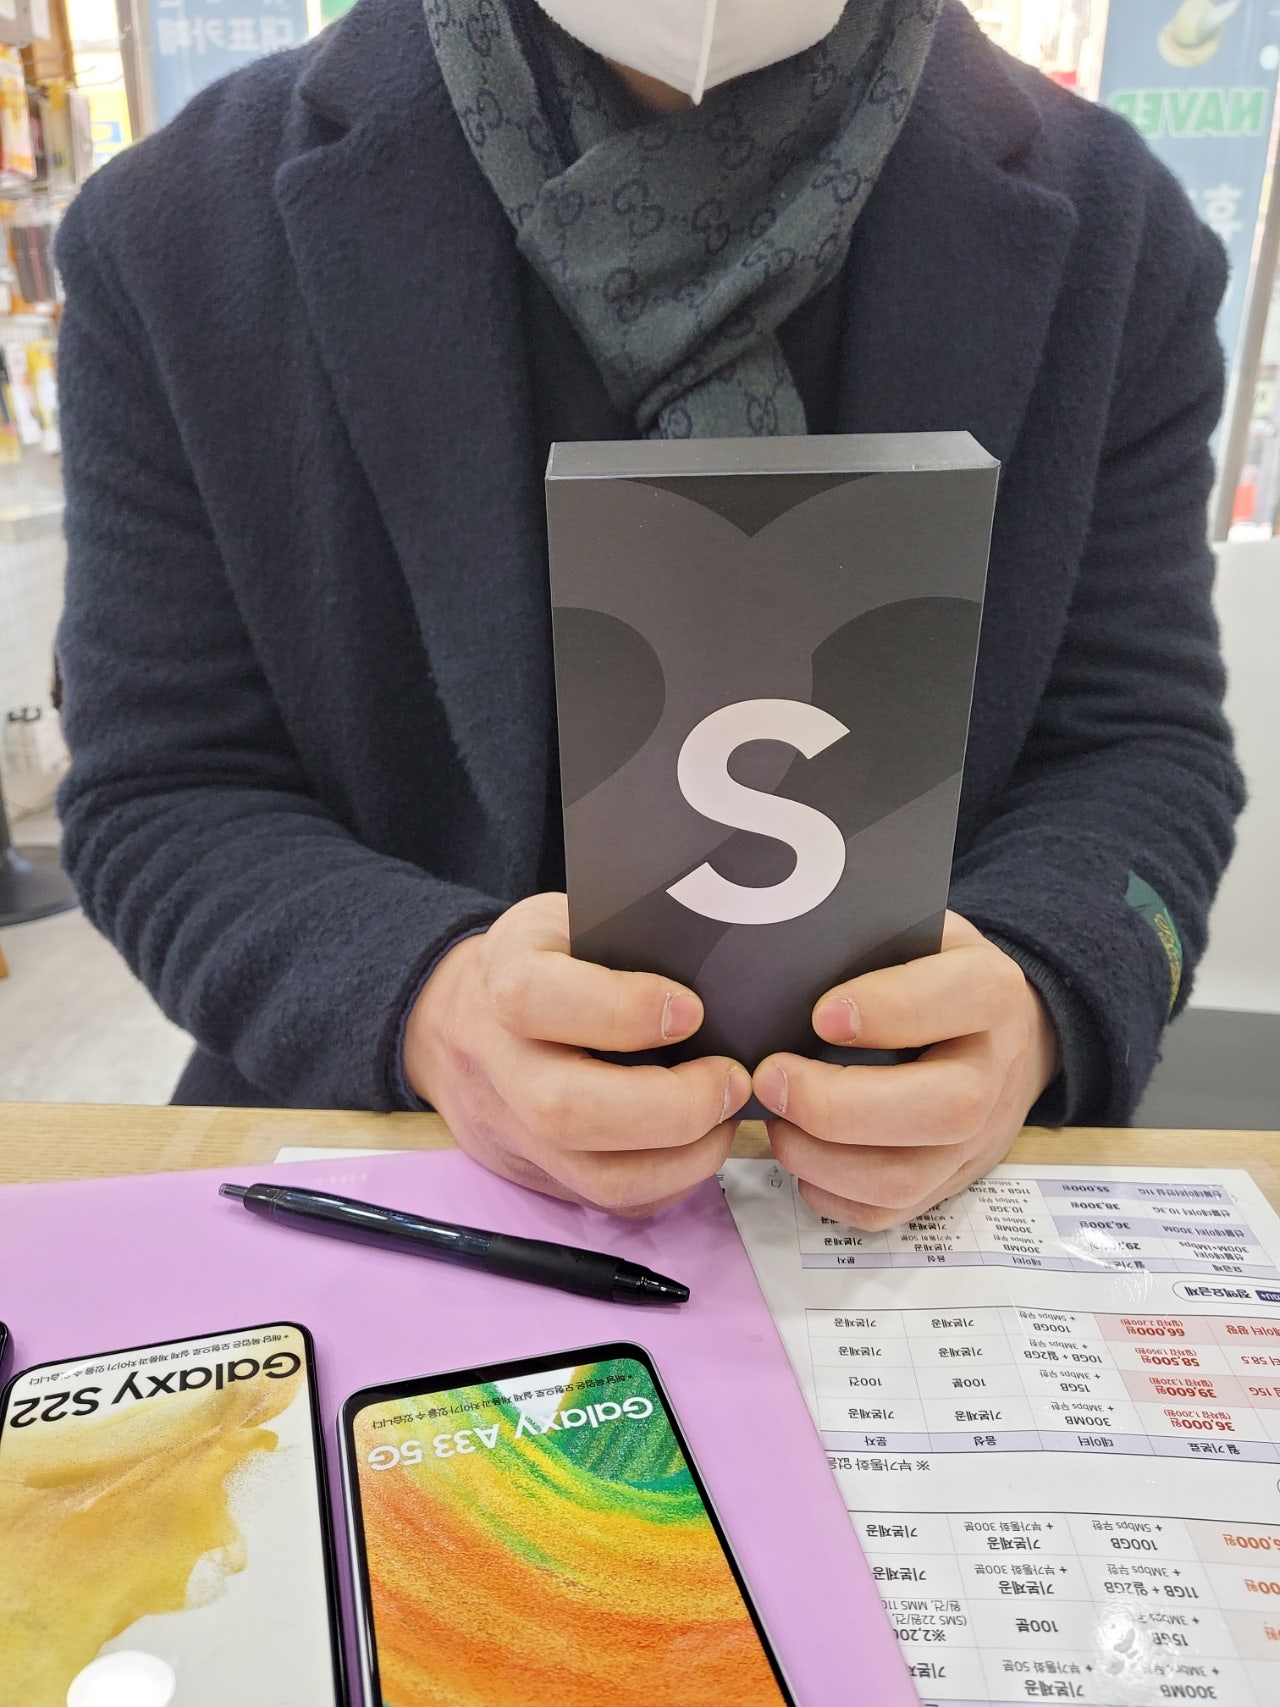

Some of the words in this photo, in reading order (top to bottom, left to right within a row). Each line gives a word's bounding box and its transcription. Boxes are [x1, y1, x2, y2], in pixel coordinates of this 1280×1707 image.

[665, 698, 850, 925] S
[1062, 1185, 1110, 1193] 55,000원
[995, 1224, 1032, 1234] 300MB
[1079, 1221, 1131, 1229] 36,300원
[1162, 1225, 1194, 1235] 300M
[824, 1237, 862, 1246] 기본제공
[1010, 1236, 1035, 1244] 1Mbps
[914, 1244, 953, 1252] 기본제공
[1003, 1244, 1040, 1254] 300MB
[837, 1256, 855, 1264] 문자
[1012, 1256, 1042, 1266] 데이터
[1212, 1264, 1242, 1273] 요금제
[1184, 1286, 1251, 1299] 정액요금제
[1019, 1311, 1036, 1319] 무한
[1038, 1313, 1066, 1322] 5Mbps
[834, 1318, 877, 1327] 기본제공
[930, 1318, 975, 1328] 기본제공
[1033, 1323, 1071, 1333] 100GB
[1126, 1326, 1185, 1336] 66,000원
[232, 1337, 261, 1350] 목업은
[263, 1334, 282, 1344] 해당
[1029, 1339, 1046, 1347] 무한
[192, 1343, 230, 1358] 모형으로
[838, 1346, 882, 1356] 기본제공
[1048, 1341, 1077, 1350] 3Mbps
[170, 1349, 190, 1360] 실제
[938, 1347, 983, 1357] 기본제공
[1024, 1350, 1059, 1360] 일2GB
[139, 1354, 168, 1367] 제품과
[1071, 1353, 1103, 1364] 10GB
[1141, 1355, 1200, 1367] 58,500원
[1241, 1356, 1267, 1364] 58.5
[85, 1364, 105, 1376] 있을
[107, 1358, 137, 1371] 차이가
[111, 1352, 301, 1404] Galaxy
[605, 1374, 626, 1384] 해당
[1039, 1369, 1058, 1378] 무한
[1060, 1370, 1090, 1380] 3Mbps
[848, 1377, 882, 1387] 100건
[952, 1378, 987, 1388] 100분
[536, 1384, 574, 1398] 모형으로
[1060, 1383, 1091, 1393] 15GB
[1155, 1385, 1217, 1398] 39,600원
[1249, 1387, 1272, 1396] 15G
[480, 1395, 511, 1408] 제품과
[513, 1391, 534, 1402] 실제
[10, 1386, 102, 1428] S22
[450, 1402, 480, 1415] 차이가
[1050, 1401, 1070, 1411] 무한
[1072, 1403, 1103, 1412] 3Mbps
[415, 1410, 426, 1420] 수
[427, 1407, 448, 1419] 있을
[514, 1396, 652, 1439] Galaxy
[848, 1408, 895, 1420] 기본제공
[954, 1410, 1002, 1422] 기본제공
[372, 1413, 414, 1429] 있습니다
[1065, 1416, 1111, 1427] 300MB
[1170, 1418, 1235, 1431] 36,000원
[432, 1423, 500, 1458] A33
[864, 1436, 887, 1447] 문자
[973, 1436, 997, 1446] 음성
[1078, 1436, 1114, 1447] 데이터
[1187, 1442, 1224, 1453] 기본료
[1226, 1444, 1240, 1455] 월
[368, 1439, 422, 1471] 5G
[856, 1458, 912, 1471] 부가통화
[866, 1524, 918, 1538] 기본제공
[963, 1521, 995, 1531] 300분
[999, 1520, 1042, 1532] 부가통화
[1092, 1520, 1113, 1531] 무한
[1116, 1521, 1151, 1532] 5Mbps
[986, 1537, 1040, 1550] 기본제공
[1110, 1538, 1158, 1551] 100GB
[872, 1567, 926, 1581] 기본제공
[974, 1564, 1007, 1574] 300분
[1011, 1564, 1054, 1576] 부가통화
[1106, 1564, 1129, 1576] 무한
[1132, 1565, 1168, 1577] 3Mbps
[998, 1581, 1054, 1595] 기본제공
[1104, 1581, 1149, 1596] 일2GB
[1163, 1585, 1199, 1598] 11GB
[900, 1600, 928, 1611] MMS
[938, 1614, 968, 1625] (SMS
[1016, 1619, 1058, 1633] 100분
[1002, 1660, 1030, 1672] 50분
[1033, 1660, 1080, 1674] 부가통화
[1024, 1680, 1084, 1698] 기본제공
[1160, 1685, 1217, 1699] 300MB
